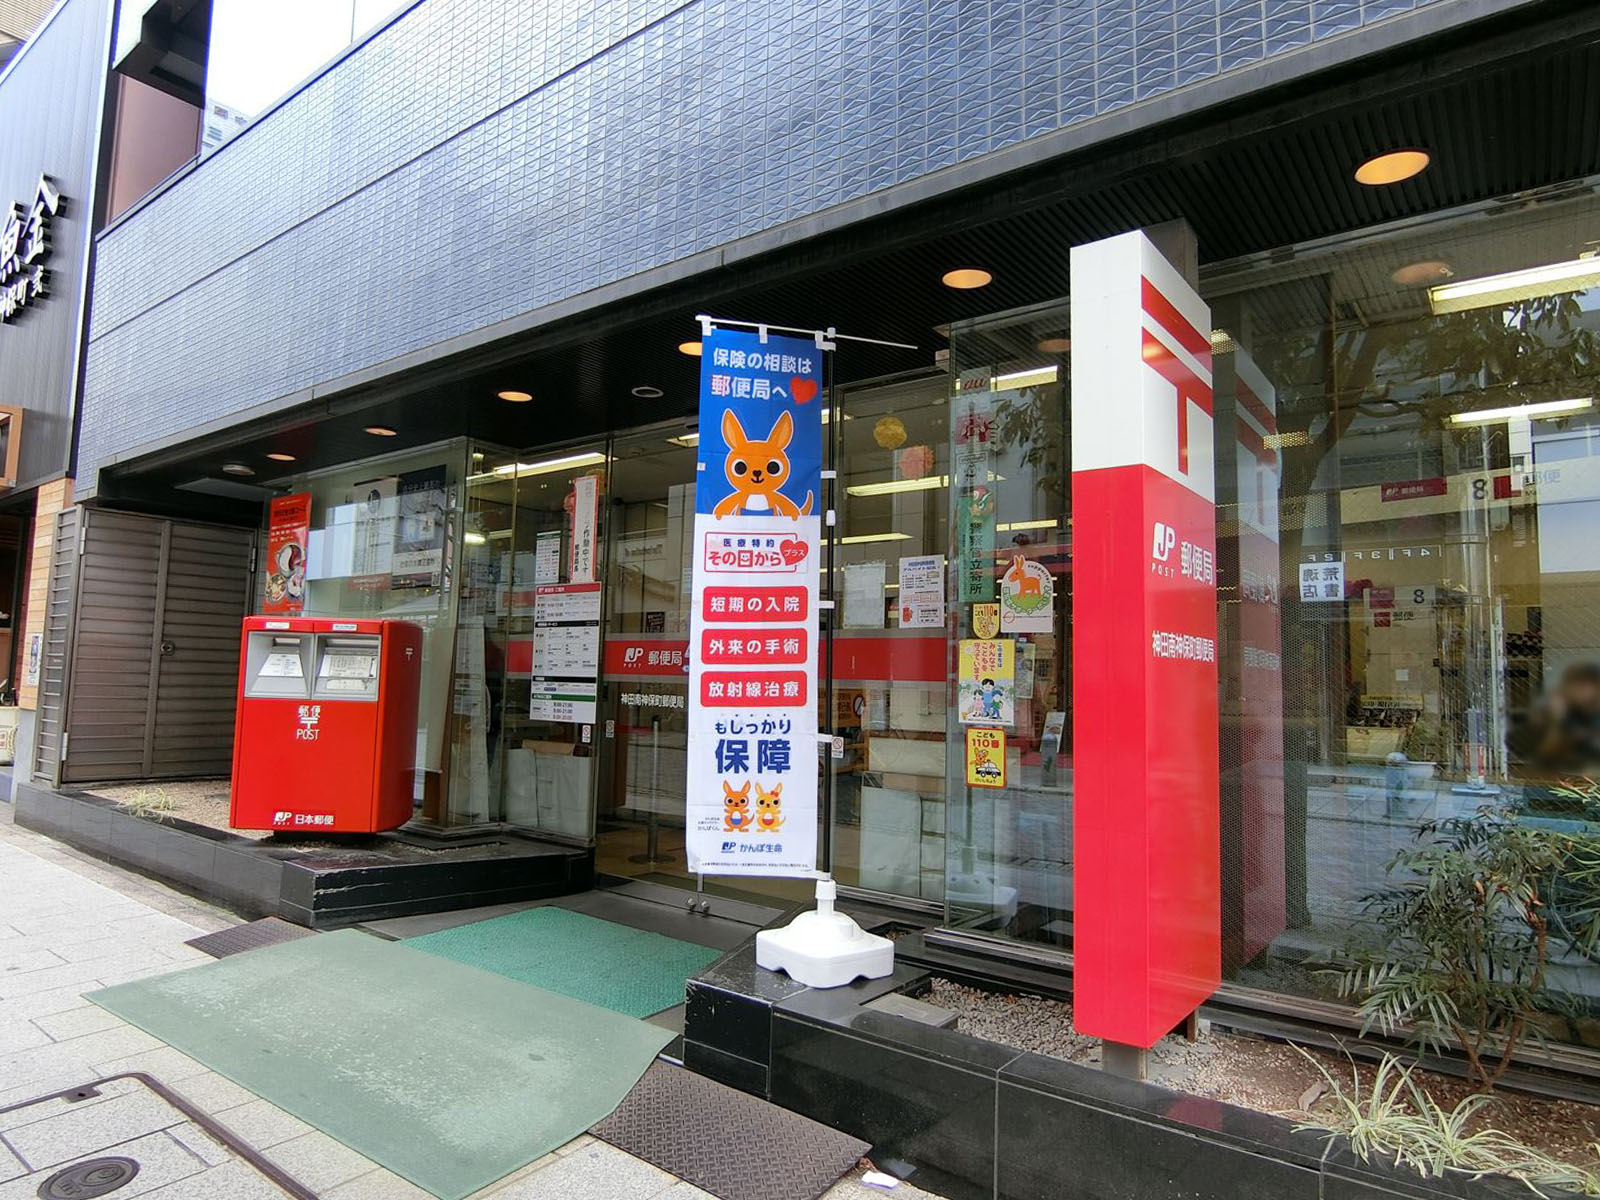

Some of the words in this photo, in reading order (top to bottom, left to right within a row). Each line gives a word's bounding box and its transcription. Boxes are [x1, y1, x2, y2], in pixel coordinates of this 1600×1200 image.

[713, 347, 812, 374] 保険の相談は
[711, 374, 787, 400] 郵便局へ
[723, 538, 775, 548] 医療特約
[784, 548, 805, 557] プラス
[1152, 563, 1175, 579] POST
[1181, 541, 1212, 585] 郵便局
[710, 596, 800, 613] 短期の入院
[709, 638, 800, 655] 外来の手術
[648, 650, 683, 666] 郵便局
[708, 681, 799, 698] 放射線治療
[298, 705, 321, 718] 郵便
[296, 728, 320, 740] POST
[715, 719, 792, 735] もしっかり
[976, 731, 996, 739] こども
[715, 739, 791, 774] 保障
[295, 814, 334, 825] 日本郵便
[740, 843, 783, 853] かんぽ生命
